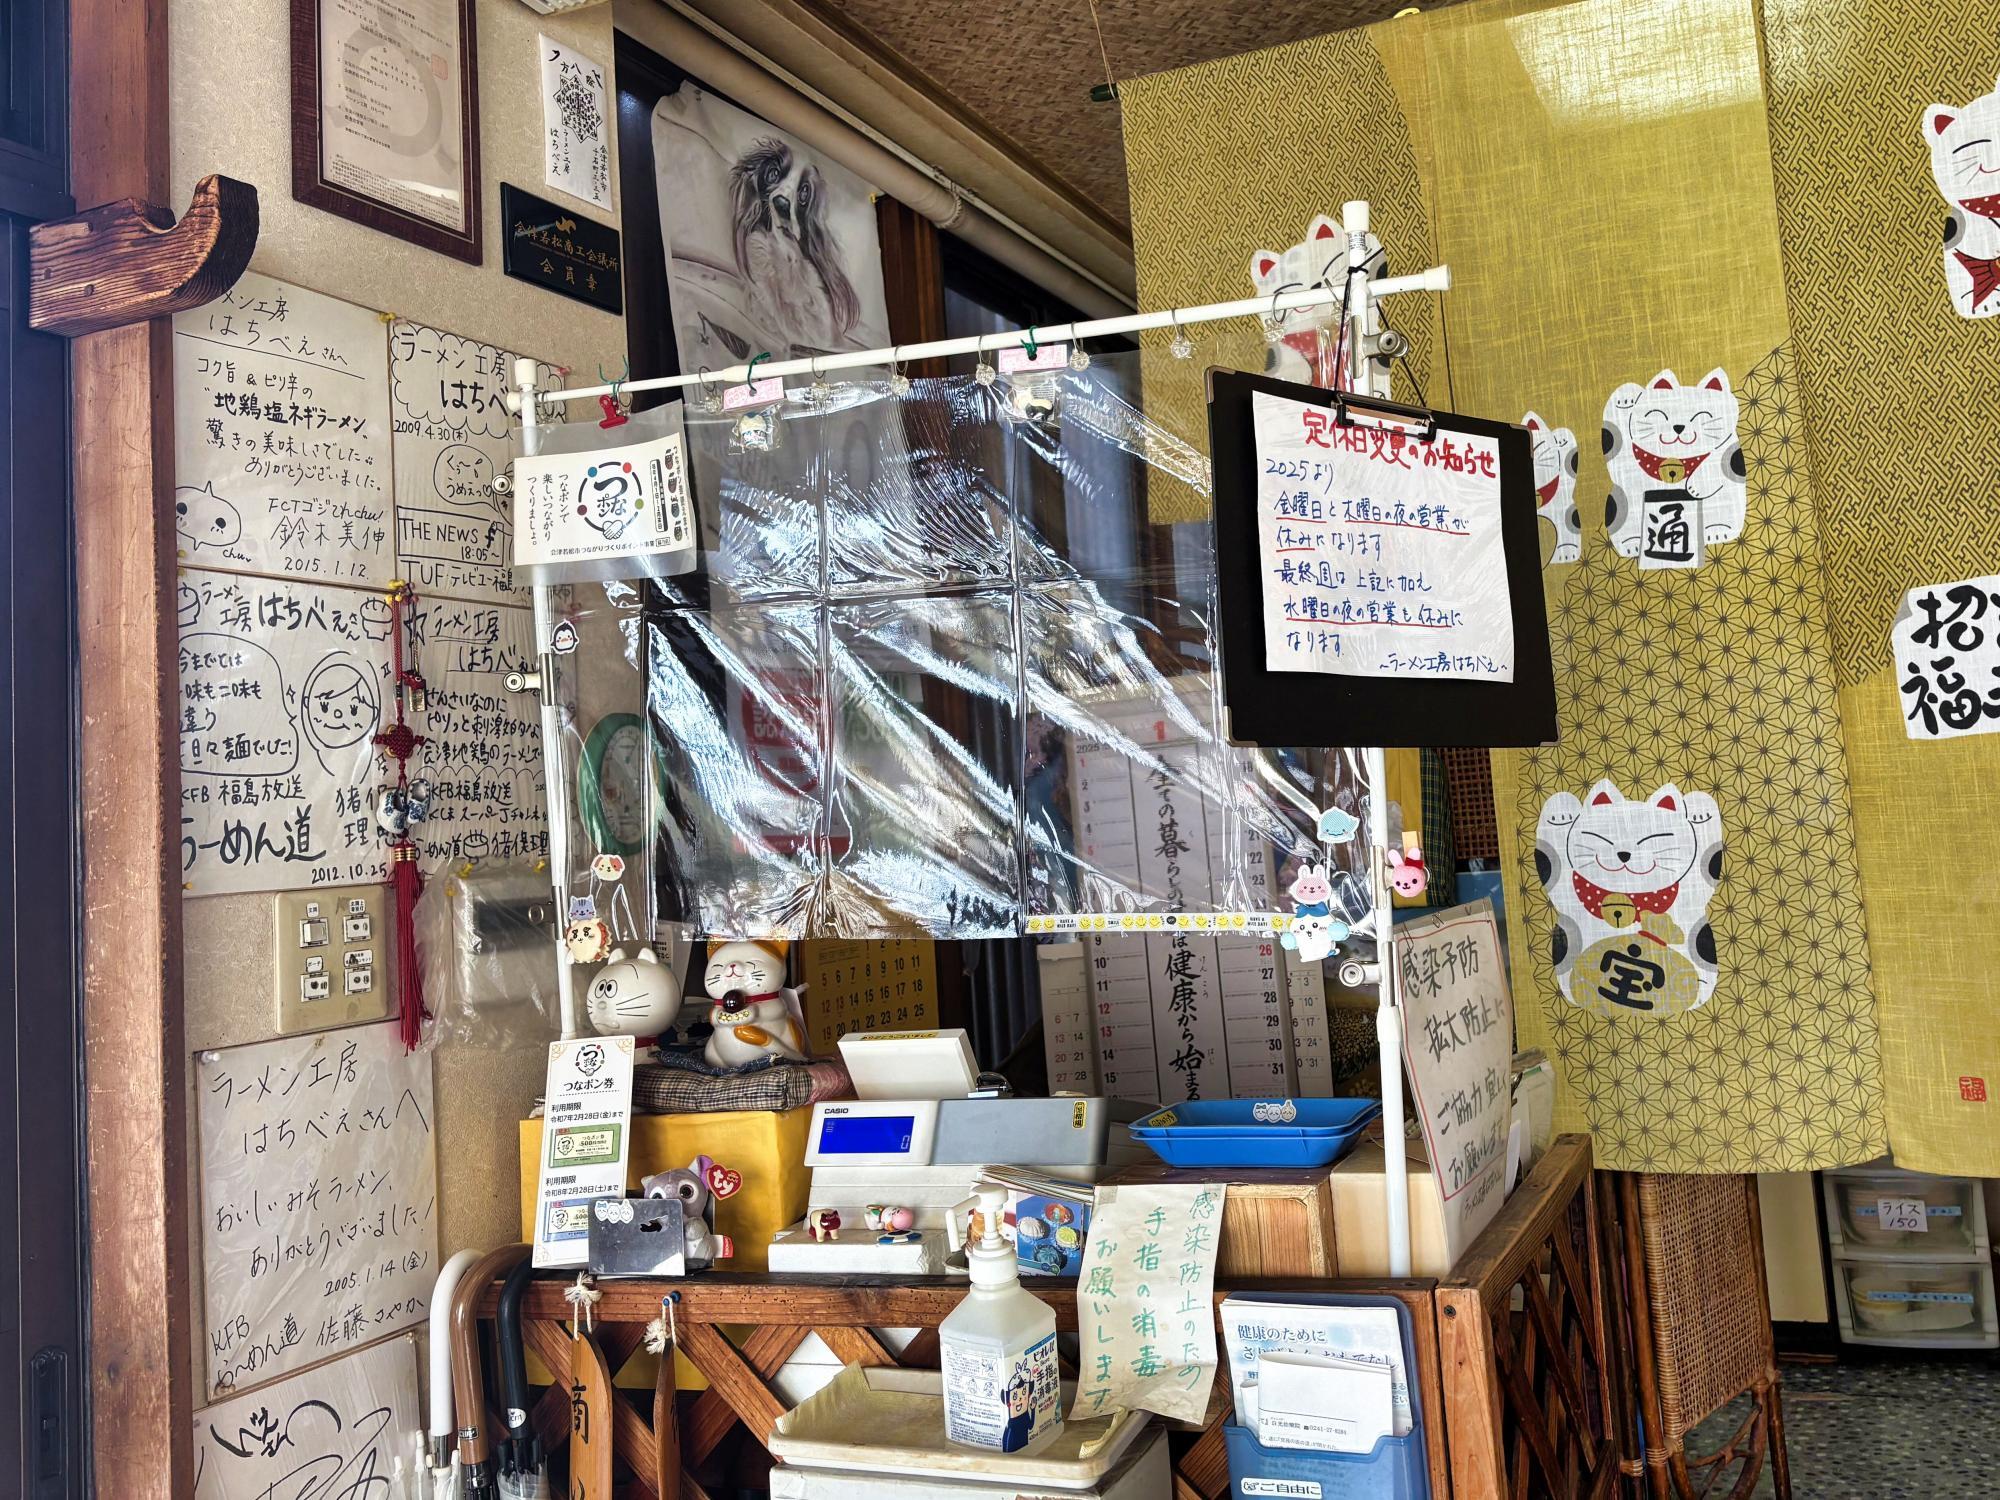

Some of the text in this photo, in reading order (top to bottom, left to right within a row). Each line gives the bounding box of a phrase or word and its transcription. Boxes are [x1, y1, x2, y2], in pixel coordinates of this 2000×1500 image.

[514, 220, 618, 271] 会津若松商工会議所
[209, 314, 347, 366] はちべえさんへ
[401, 332, 505, 382] ラーメン工房
[1302, 408, 1497, 478] 定休日変更のお知らせ
[244, 456, 381, 491] ありがとうございました。
[1266, 458, 1335, 495] 2025より
[543, 473, 553, 542] 楽しいつながり
[558, 474, 570, 524] つなポンで
[399, 517, 432, 541] THE
[436, 523, 479, 544] NEWS
[1643, 502, 1695, 562] 通
[1276, 525, 1382, 561] 休みになります
[400, 559, 444, 588] TUF
[201, 581, 243, 606] ラーメン
[220, 601, 251, 632] 工房
[258, 592, 348, 633] はちべえ
[433, 605, 500, 643] ラーメン工房
[180, 678, 262, 702] 味も二味も
[218, 774, 306, 806] 福島放送
[1250, 852, 1263, 864] 22
[311, 863, 388, 885] 2012.10.25
[1252, 874, 1265, 886] 23
[1259, 944, 1272, 956] 26
[865, 964, 871, 977] 8
[880, 961, 886, 973] 9
[894, 958, 904, 971] 10
[911, 955, 920, 968] 11
[1094, 957, 1106, 969] 10
[1402, 935, 1479, 998] 感染予防
[1261, 968, 1274, 980] 27
[1597, 943, 1665, 1010] 宝
[849, 992, 859, 1006] 14
[864, 989, 874, 1003] 15
[880, 986, 890, 999] 16
[896, 982, 905, 996] 17
[912, 979, 923, 992] 18
[1097, 980, 1108, 992] 11
[1264, 991, 1277, 1003] 28
[1304, 997, 1313, 1007] 10
[866, 1015, 875, 1028] 22
[881, 1011, 891, 1025] 23
[897, 1007, 908, 1020] 24
[914, 1004, 924, 1017] 25
[1098, 1003, 1110, 1015] 12
[1073, 1013, 1079, 1023] 7
[1266, 1015, 1279, 1027] 29
[1306, 1017, 1315, 1027] 17
[1074, 1032, 1083, 1042] 14
[1100, 1026, 1112, 1038] 13
[1269, 1039, 1282, 1051] 30
[1308, 1038, 1317, 1048] 24
[1074, 1052, 1084, 1062] 21
[1102, 1049, 1114, 1061] 14
[1309, 1058, 1318, 1068] 31
[211, 1039, 358, 1109] ラーメン工房
[1075, 1071, 1087, 1081] 28
[1272, 1063, 1284, 1075] 31
[564, 1078, 614, 1092] つなポン券
[1105, 1072, 1117, 1084] 15
[551, 1101, 582, 1112] 利用期限
[243, 1088, 429, 1154] はちべえさんへ
[550, 1111, 624, 1123] 令和7年2月28日(金)まで
[900, 1135, 911, 1150] 0
[546, 1175, 577, 1186] 利用期限
[544, 1184, 619, 1197] 令和8年2月28日(土)まで
[1882, 1201, 1921, 1216] ライス
[1889, 1217, 1918, 1229] 150
[323, 1250, 428, 1297] 2005.1.14(金)
[1131, 1206, 1167, 1378] 手指の消毒
[1176, 1191, 1218, 1391] 感染防止のため
[1084, 1239, 1117, 1411] お願いします
[1238, 1324, 1327, 1343] 健康のために
[211, 1314, 250, 1356] KFB
[1260, 1482, 1321, 1496] ご自由に
